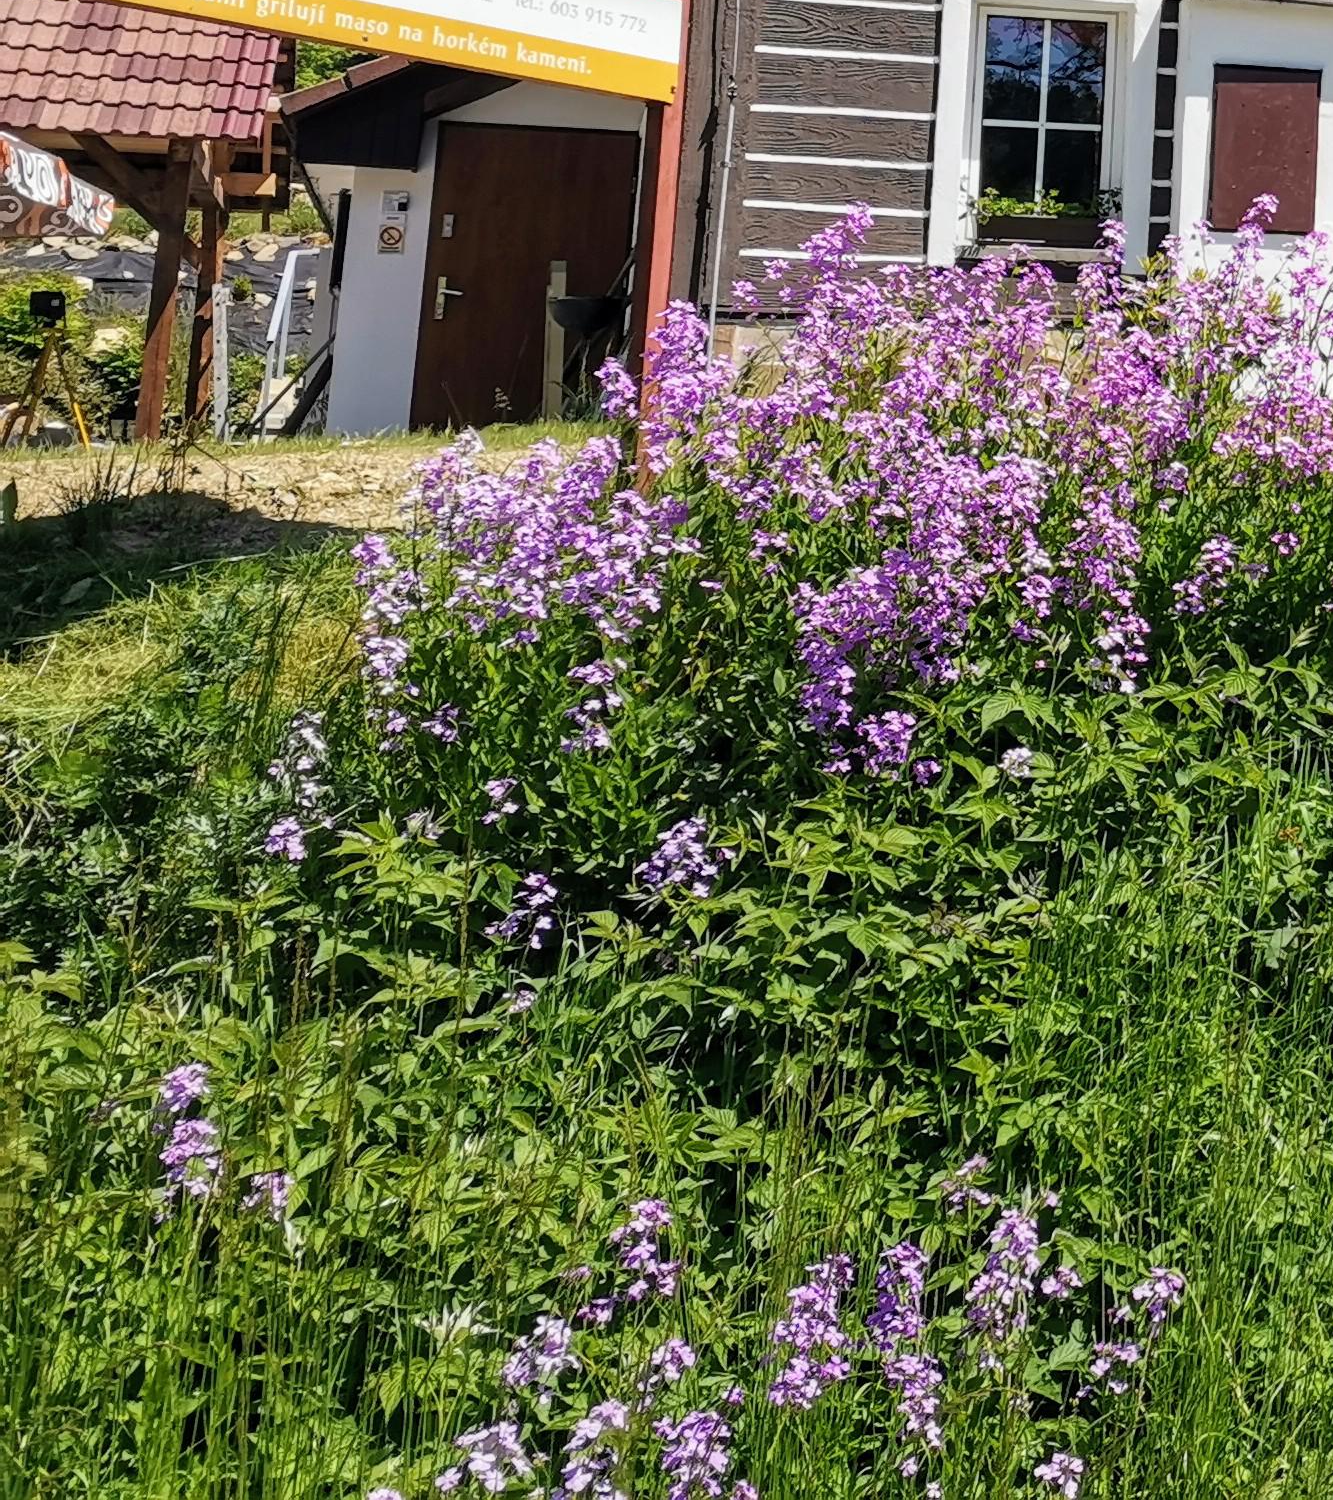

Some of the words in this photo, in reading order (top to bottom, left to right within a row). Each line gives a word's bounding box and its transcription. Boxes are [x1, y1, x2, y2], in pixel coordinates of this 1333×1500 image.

[335, 10, 389, 35] maso
[398, 24, 423, 42] na
[433, 26, 507, 58] horkém
[549, 0, 579, 19] 603
[585, 7, 613, 27] 915
[619, 13, 647, 33] 772
